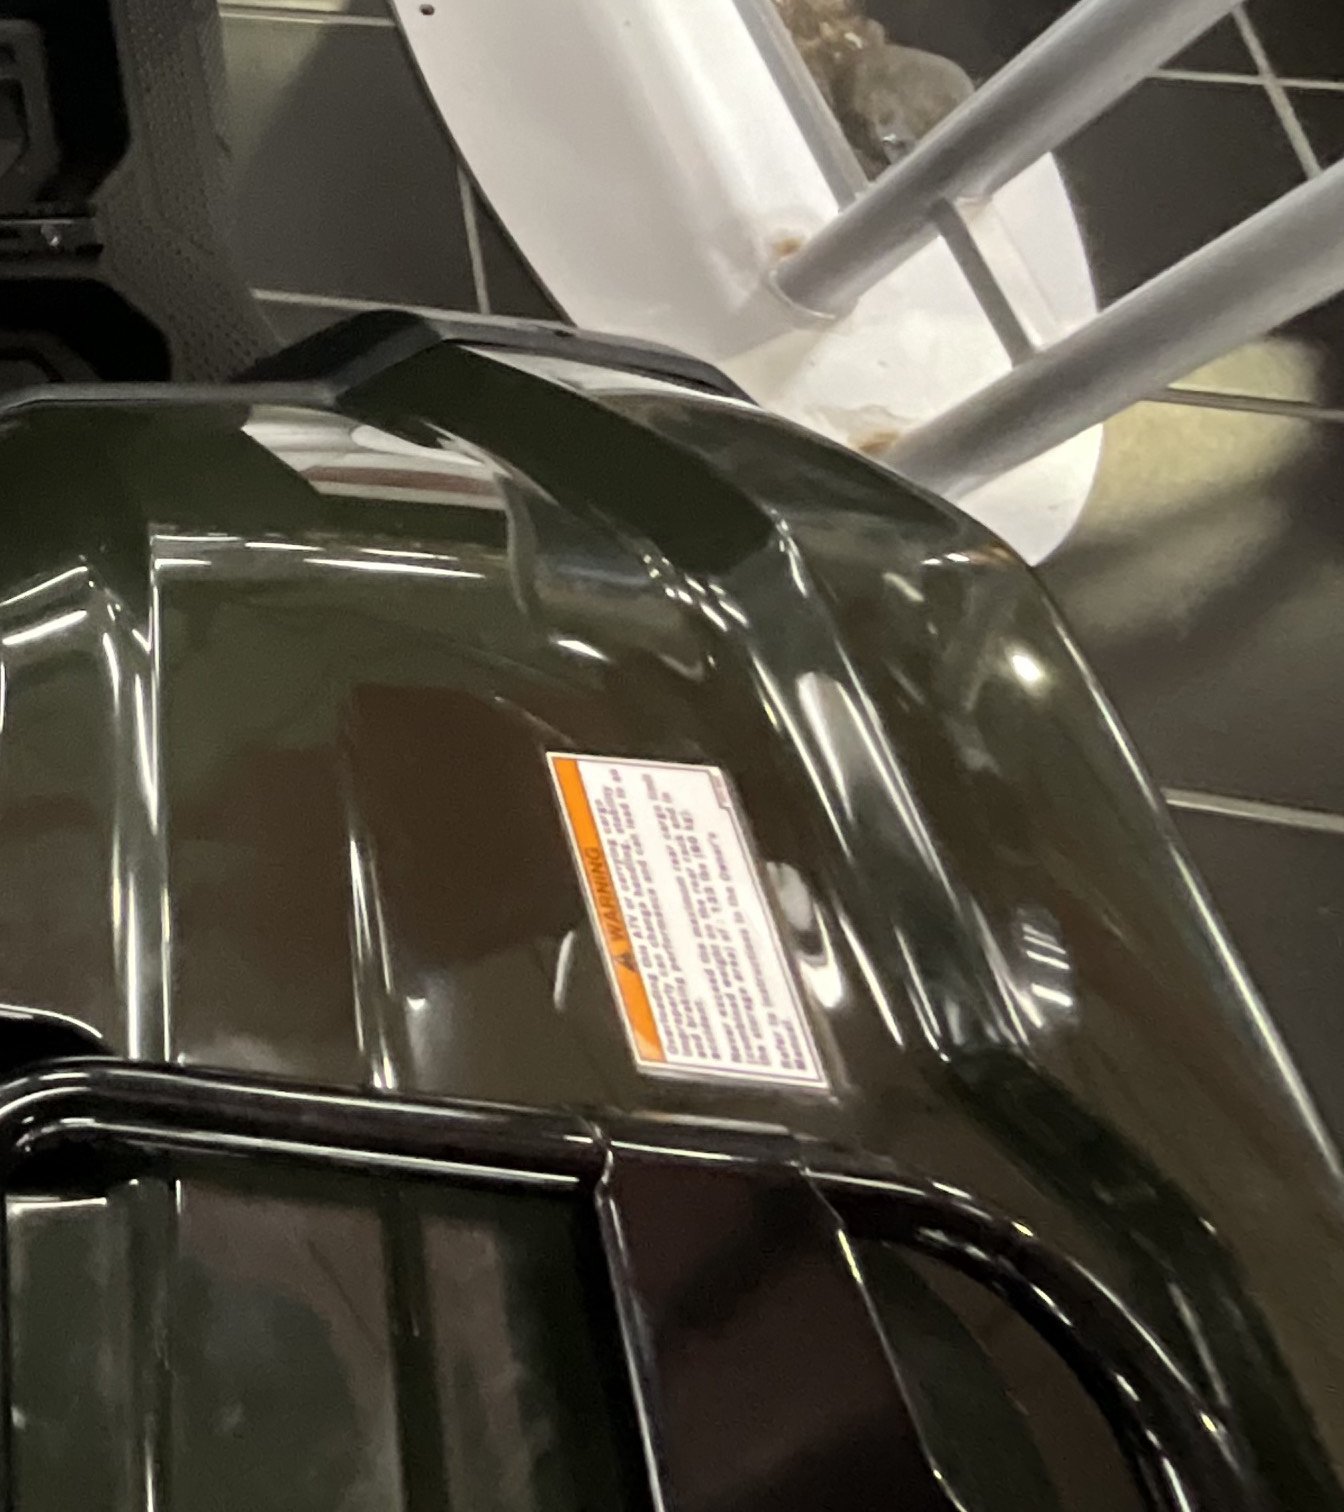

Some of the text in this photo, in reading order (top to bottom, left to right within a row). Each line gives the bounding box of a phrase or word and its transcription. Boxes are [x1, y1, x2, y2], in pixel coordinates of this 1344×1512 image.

[609, 768, 621, 782] an
[594, 798, 611, 834] cargo
[653, 805, 671, 840] cargo
[664, 807, 681, 829] and
[629, 833, 643, 855] can
[606, 838, 629, 891] carrying
[635, 859, 653, 883] and
[585, 847, 627, 942] WARNING
[623, 896, 635, 910] or
[725, 885, 738, 907] the
[696, 898, 709, 919] the
[627, 914, 643, 939] ATV
[638, 901, 663, 948] change
[704, 923, 716, 939] on
[653, 953, 668, 977] can
[697, 942, 710, 964] the
[674, 976, 697, 1028] braking
[703, 968, 727, 1017] exceed
[646, 973, 678, 1054] Overloading
[689, 1033, 707, 1058] and
[722, 1022, 742, 1063] Never
[756, 1044, 771, 1066] the
